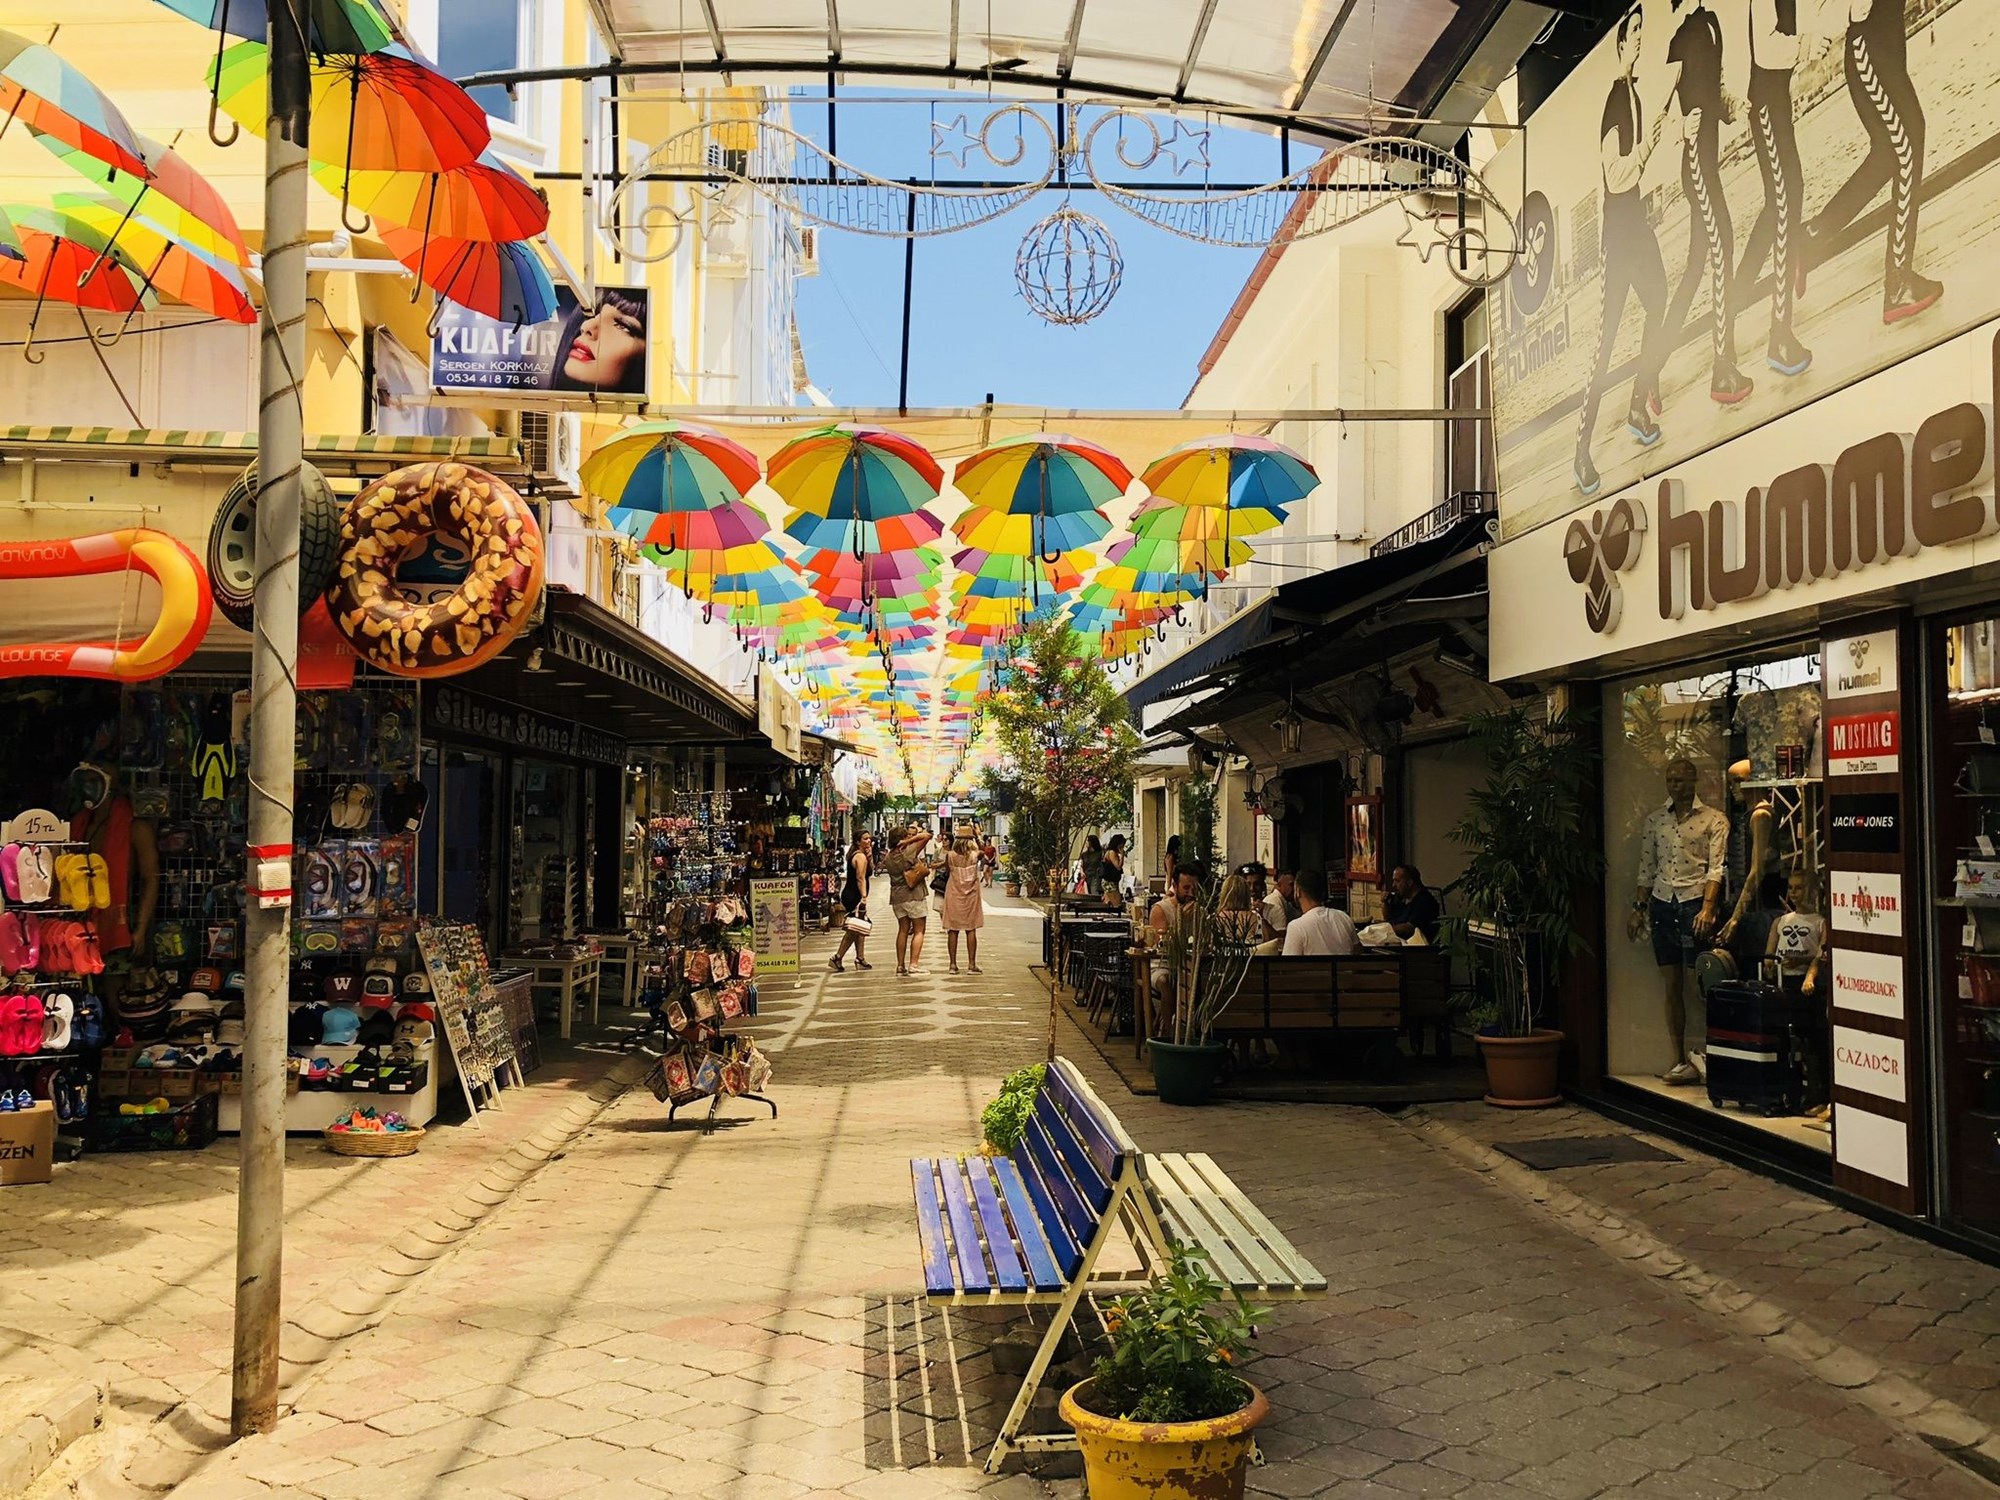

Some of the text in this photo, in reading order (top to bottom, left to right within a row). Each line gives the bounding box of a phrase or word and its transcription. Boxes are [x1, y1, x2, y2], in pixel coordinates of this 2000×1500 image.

[490, 361, 549, 372] KORKMAZ
[446, 373, 539, 385] 0534 418 78 46
[1838, 666, 1882, 691] hummel
[435, 688, 511, 739] Silver
[515, 711, 570, 753] Stone
[1833, 720, 1892, 751] MUSTANG
[25, 817, 56, 834] 15 TL
[1832, 816, 1855, 828] JACK
[1863, 816, 1894, 828] JONES
[1832, 892, 1849, 907] U.S.
[1875, 896, 1900, 912] ASSN.
[1843, 976, 1896, 998] LUMBERJACK
